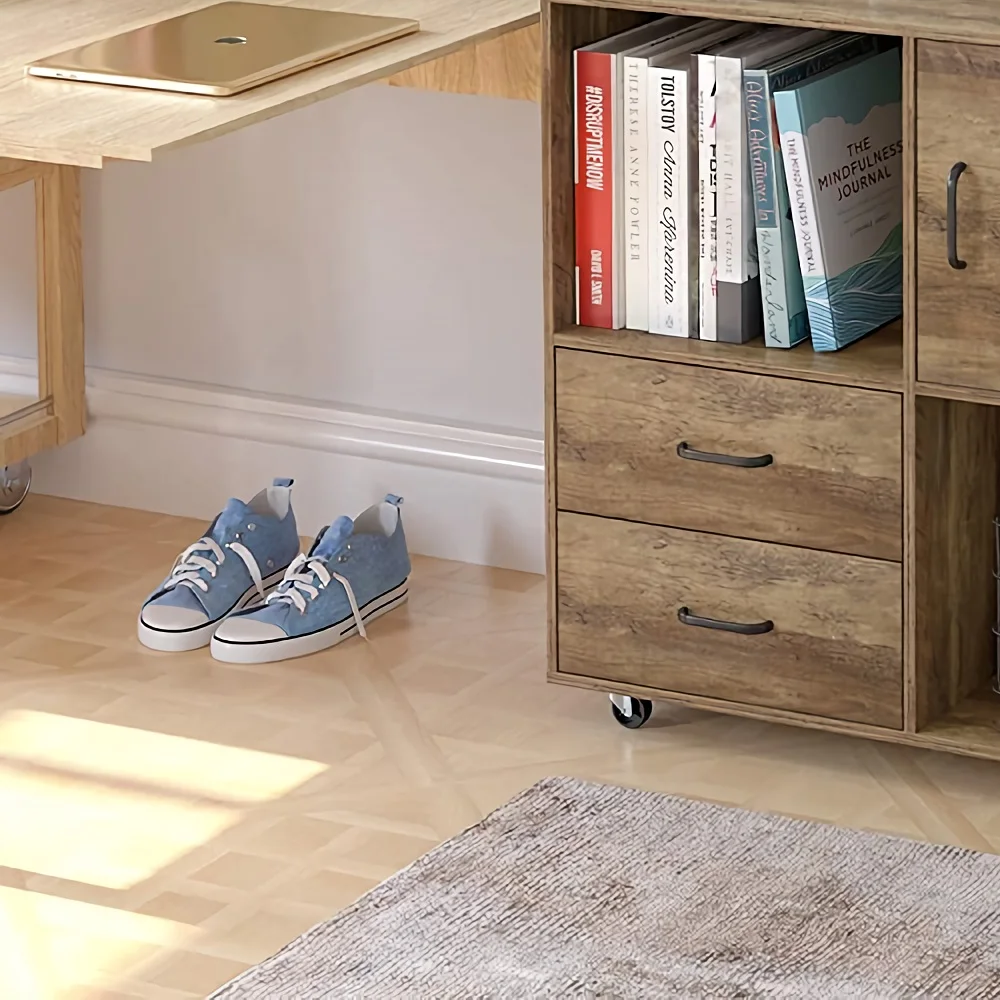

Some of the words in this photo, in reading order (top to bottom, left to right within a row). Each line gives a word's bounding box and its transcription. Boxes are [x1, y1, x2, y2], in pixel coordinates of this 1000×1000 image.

[628, 63, 639, 137] THERESE
[660, 75, 675, 133] TOLSTOY
[585, 85, 604, 191] #DISRUPTMENOW
[629, 146, 639, 188] ANNE
[818, 140, 904, 191] MINDFULNESS
[847, 136, 872, 157] THE
[664, 140, 676, 200] Anna
[838, 166, 892, 201] JOURNAL
[630, 196, 640, 261] FOWLER
[662, 206, 676, 305] Karenina
